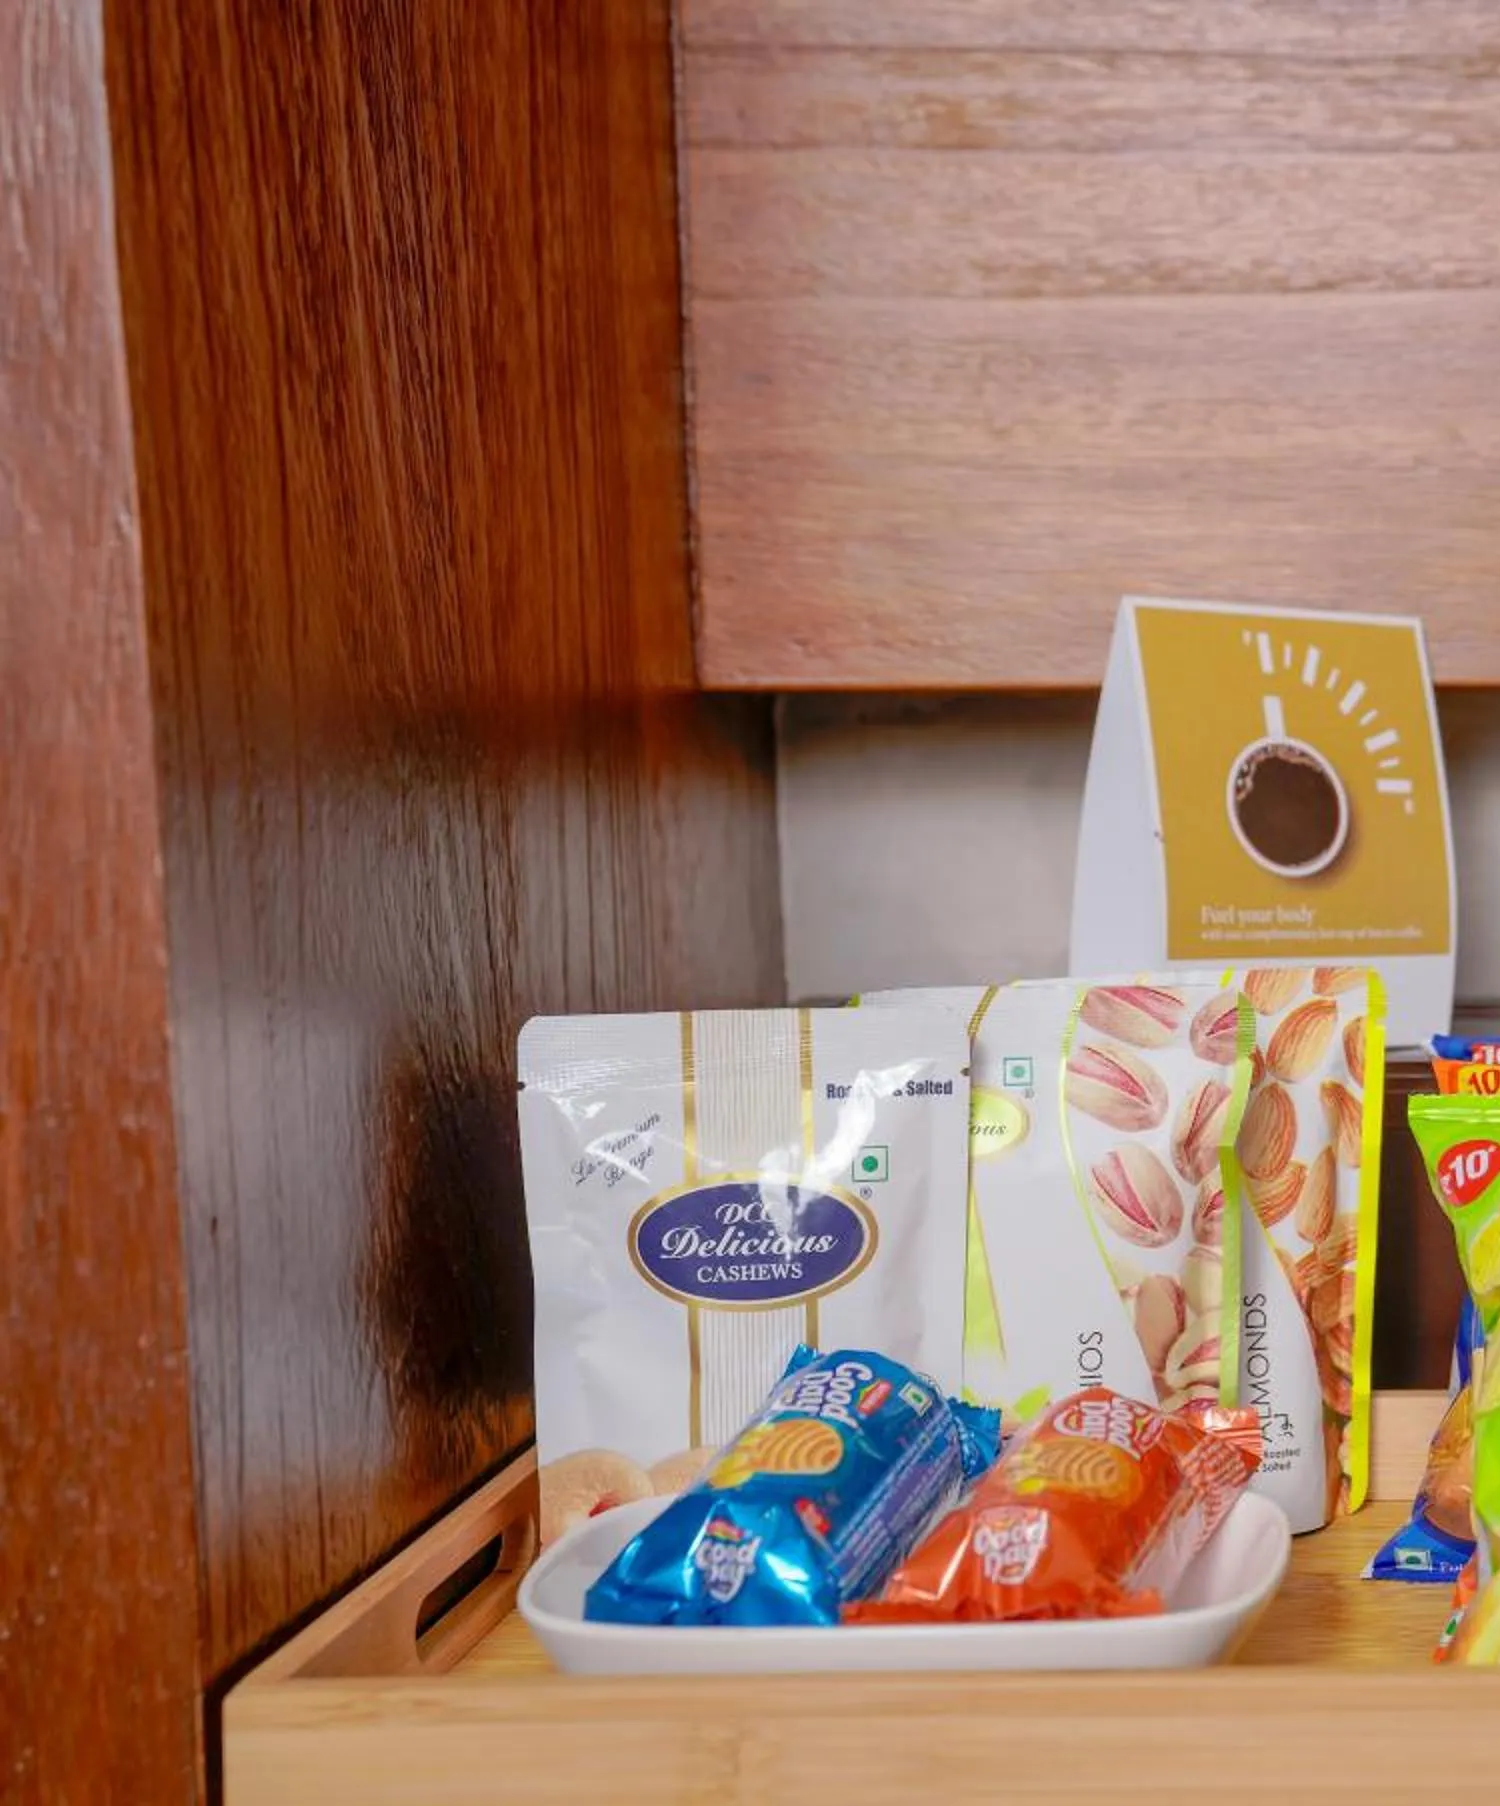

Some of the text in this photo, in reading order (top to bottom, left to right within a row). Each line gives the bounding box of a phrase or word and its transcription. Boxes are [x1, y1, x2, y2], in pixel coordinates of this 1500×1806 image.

[1238, 909, 1273, 929] your
[1277, 904, 1317, 928] body
[905, 1079, 953, 1097] Salted
[660, 1222, 839, 1260] Delicious
[697, 1261, 803, 1283] CASHEWS
